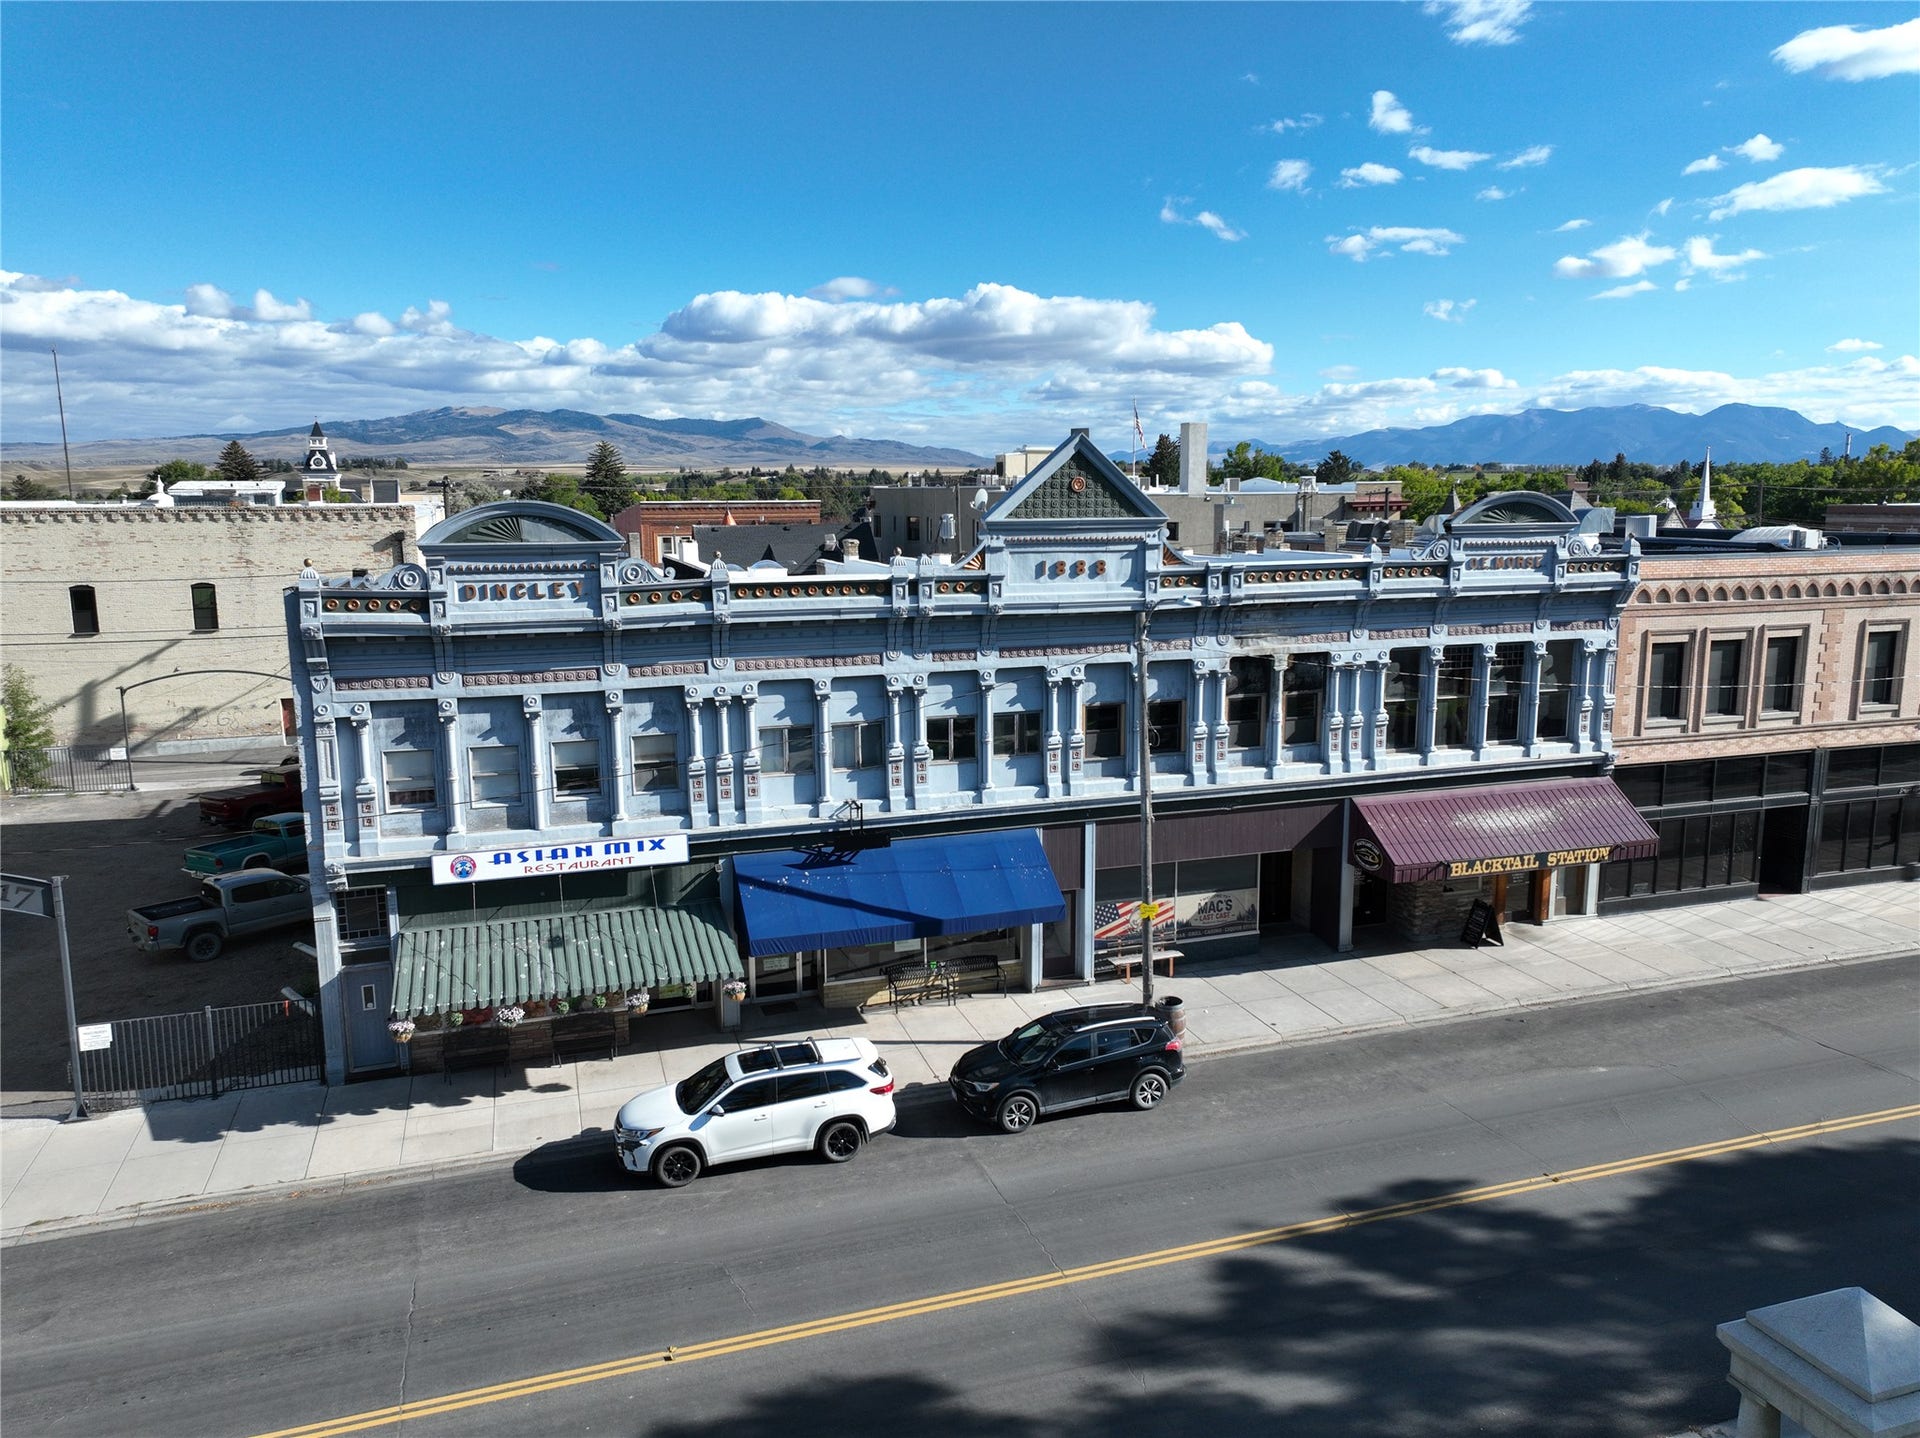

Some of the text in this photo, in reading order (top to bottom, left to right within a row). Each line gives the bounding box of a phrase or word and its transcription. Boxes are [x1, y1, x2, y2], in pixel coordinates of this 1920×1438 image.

[1042, 560, 1106, 575] 1888
[488, 844, 593, 865] ASIAN
[604, 838, 666, 855] MIX
[524, 856, 636, 874] RESTAURANT
[1450, 846, 1611, 877] BLACKTAIL STATION
[1197, 899, 1233, 915] MAC'S
